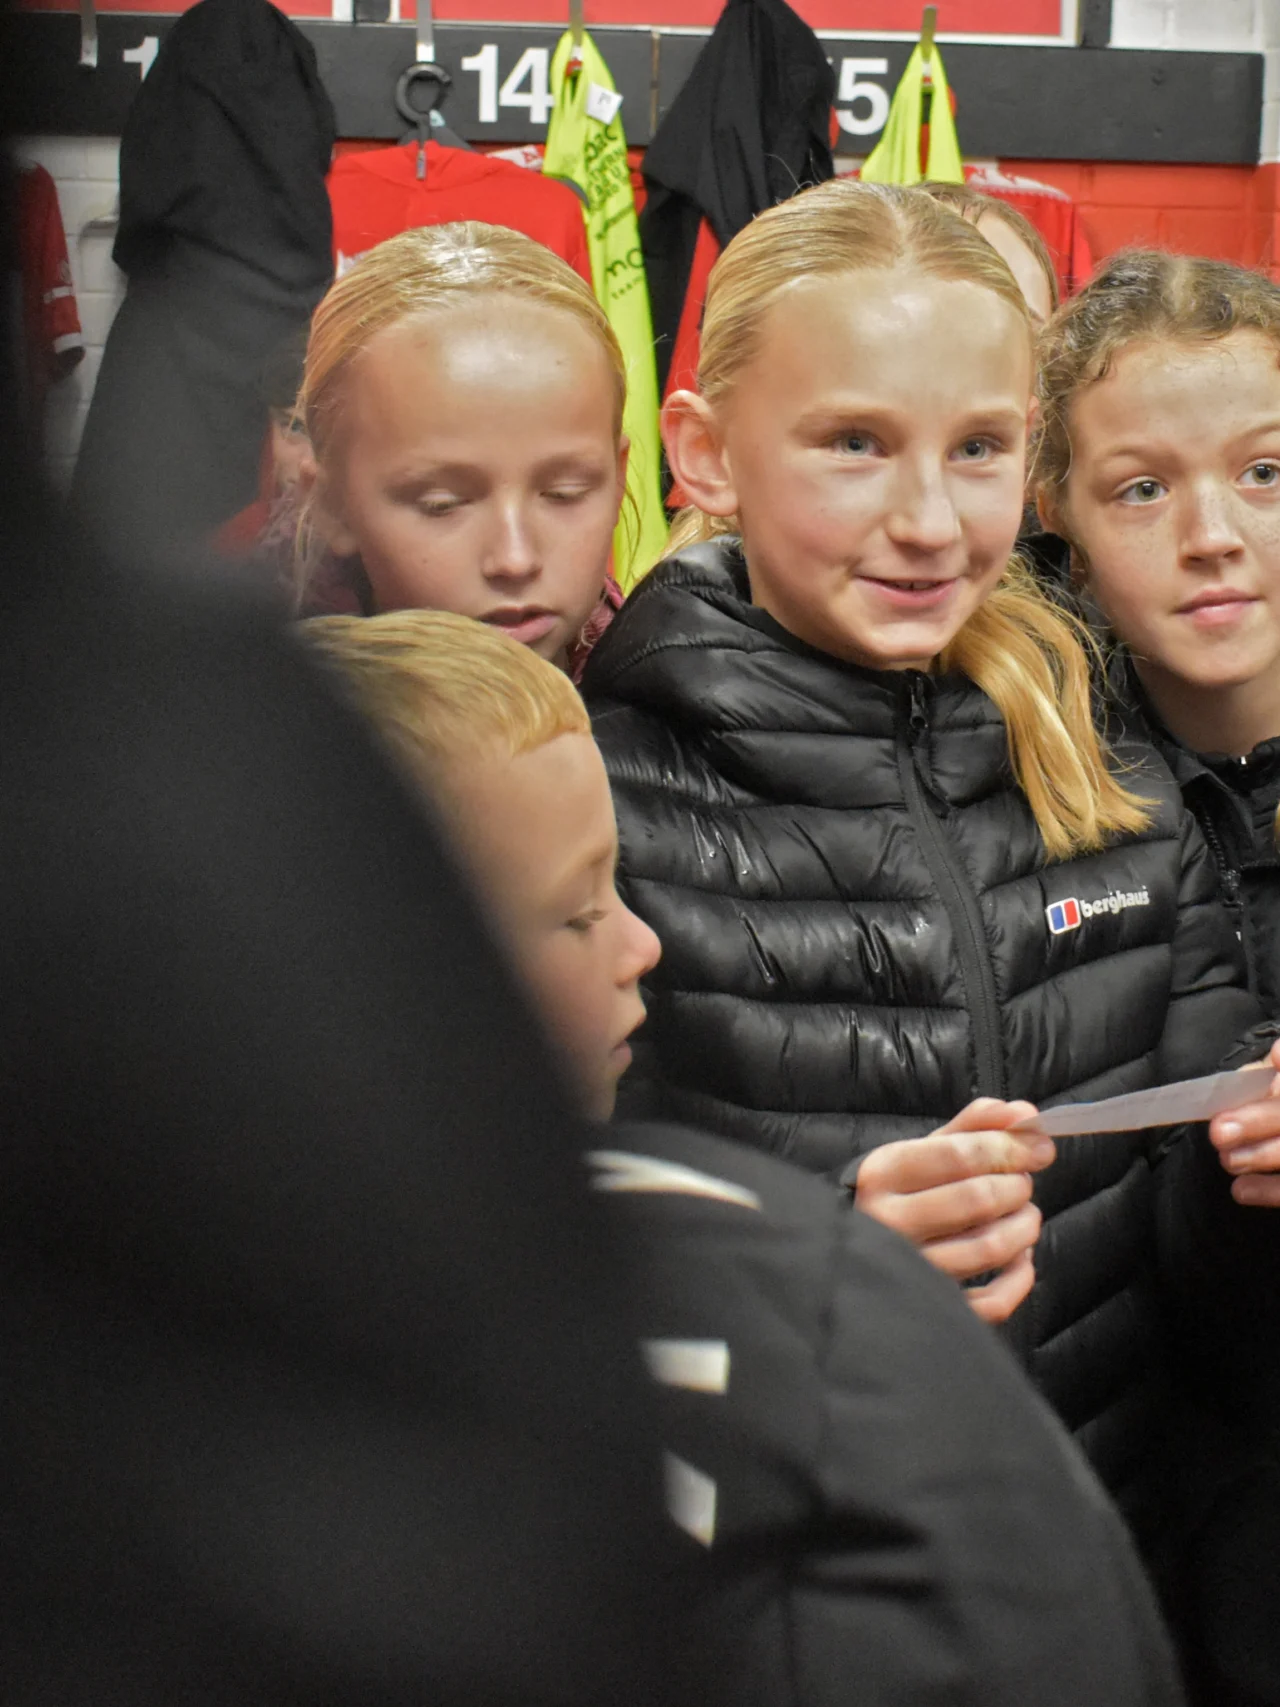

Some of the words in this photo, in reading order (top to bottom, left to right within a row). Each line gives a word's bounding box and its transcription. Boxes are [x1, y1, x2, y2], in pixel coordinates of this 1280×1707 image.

[123, 36, 160, 82] 1
[461, 43, 555, 124] 14
[826, 57, 890, 136] 5
[1079, 888, 1151, 918] berghaus
